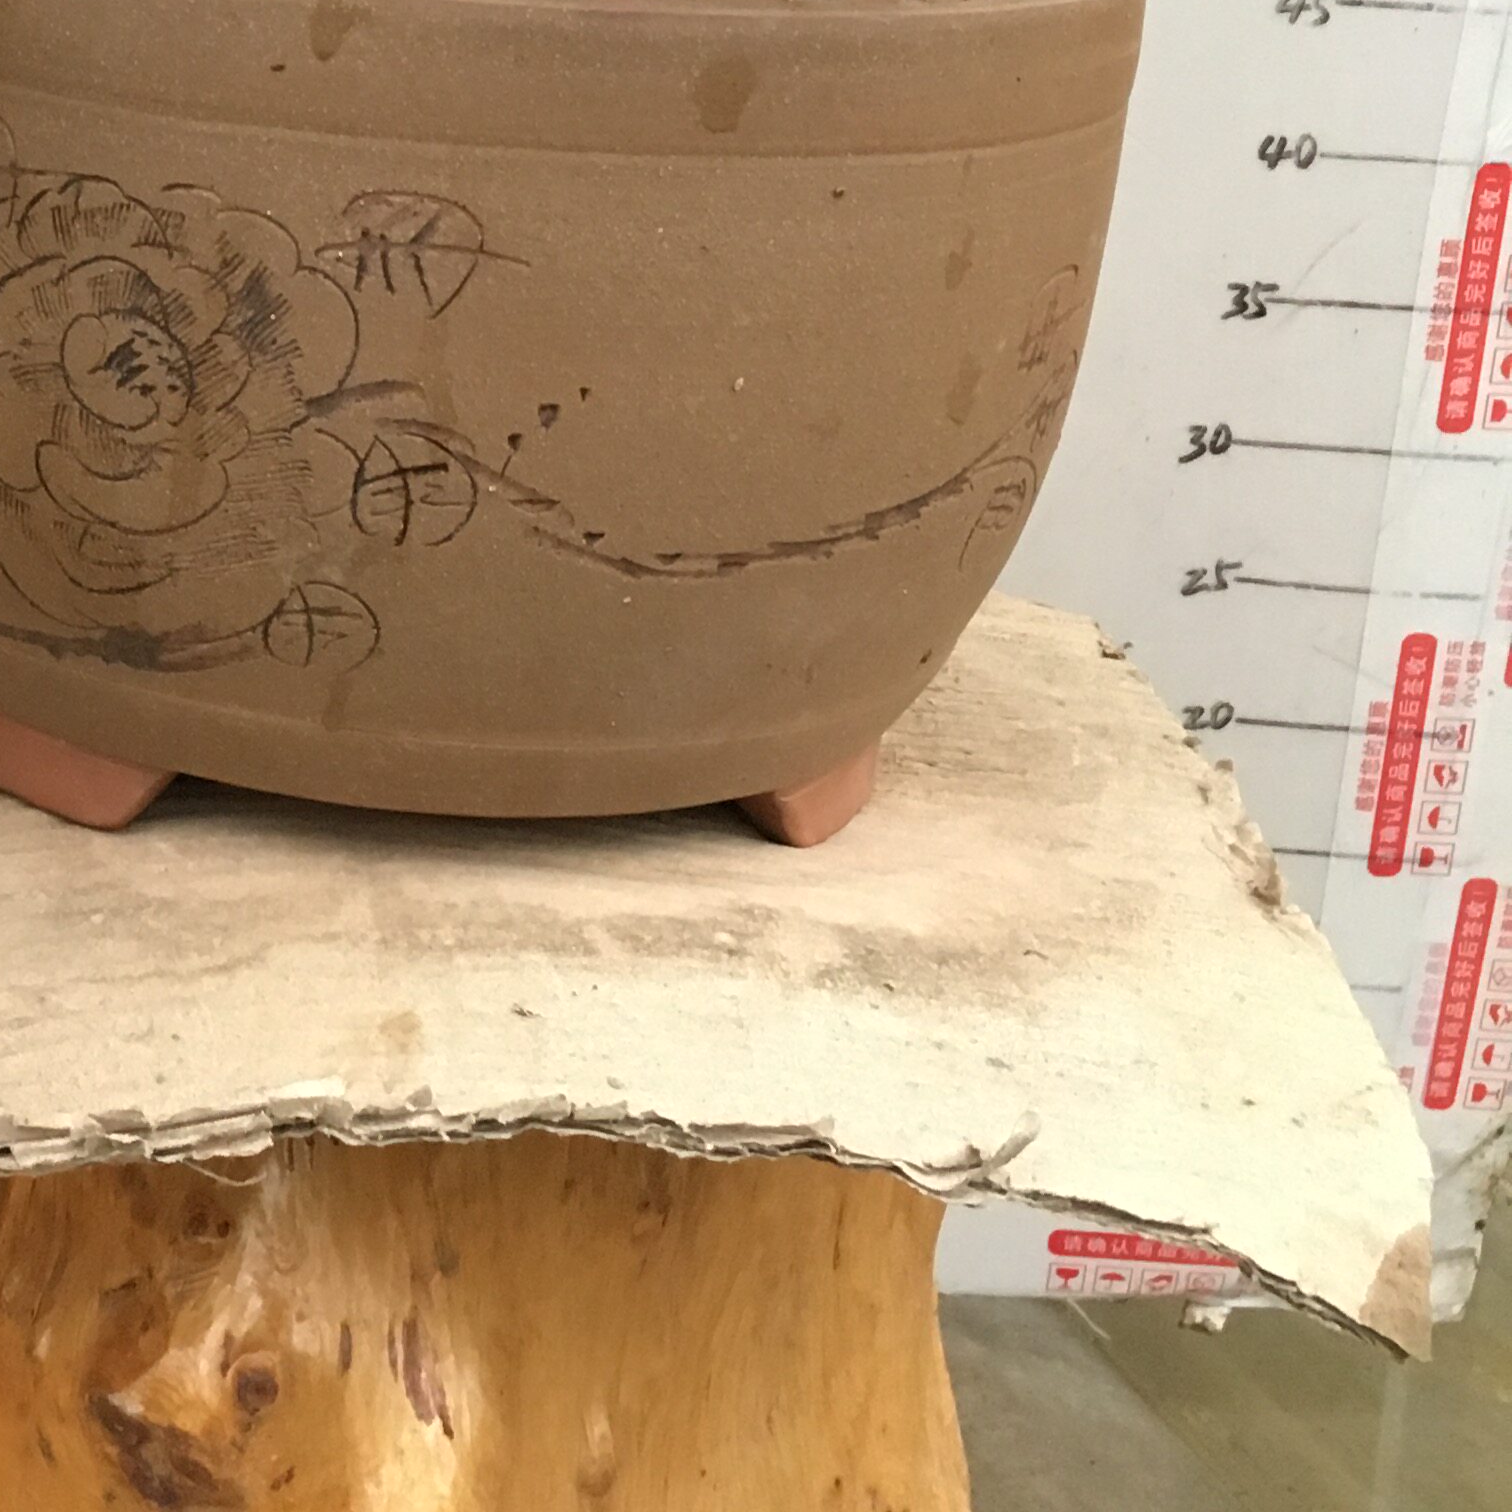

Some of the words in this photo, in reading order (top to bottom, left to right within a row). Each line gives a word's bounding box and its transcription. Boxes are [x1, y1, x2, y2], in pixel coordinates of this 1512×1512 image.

[1257, 133, 1317, 170] 40
[1221, 281, 1280, 320] 35
[1178, 423, 1232, 464] 30
[1180, 558, 1243, 596] 25
[1183, 701, 1234, 729] 20
